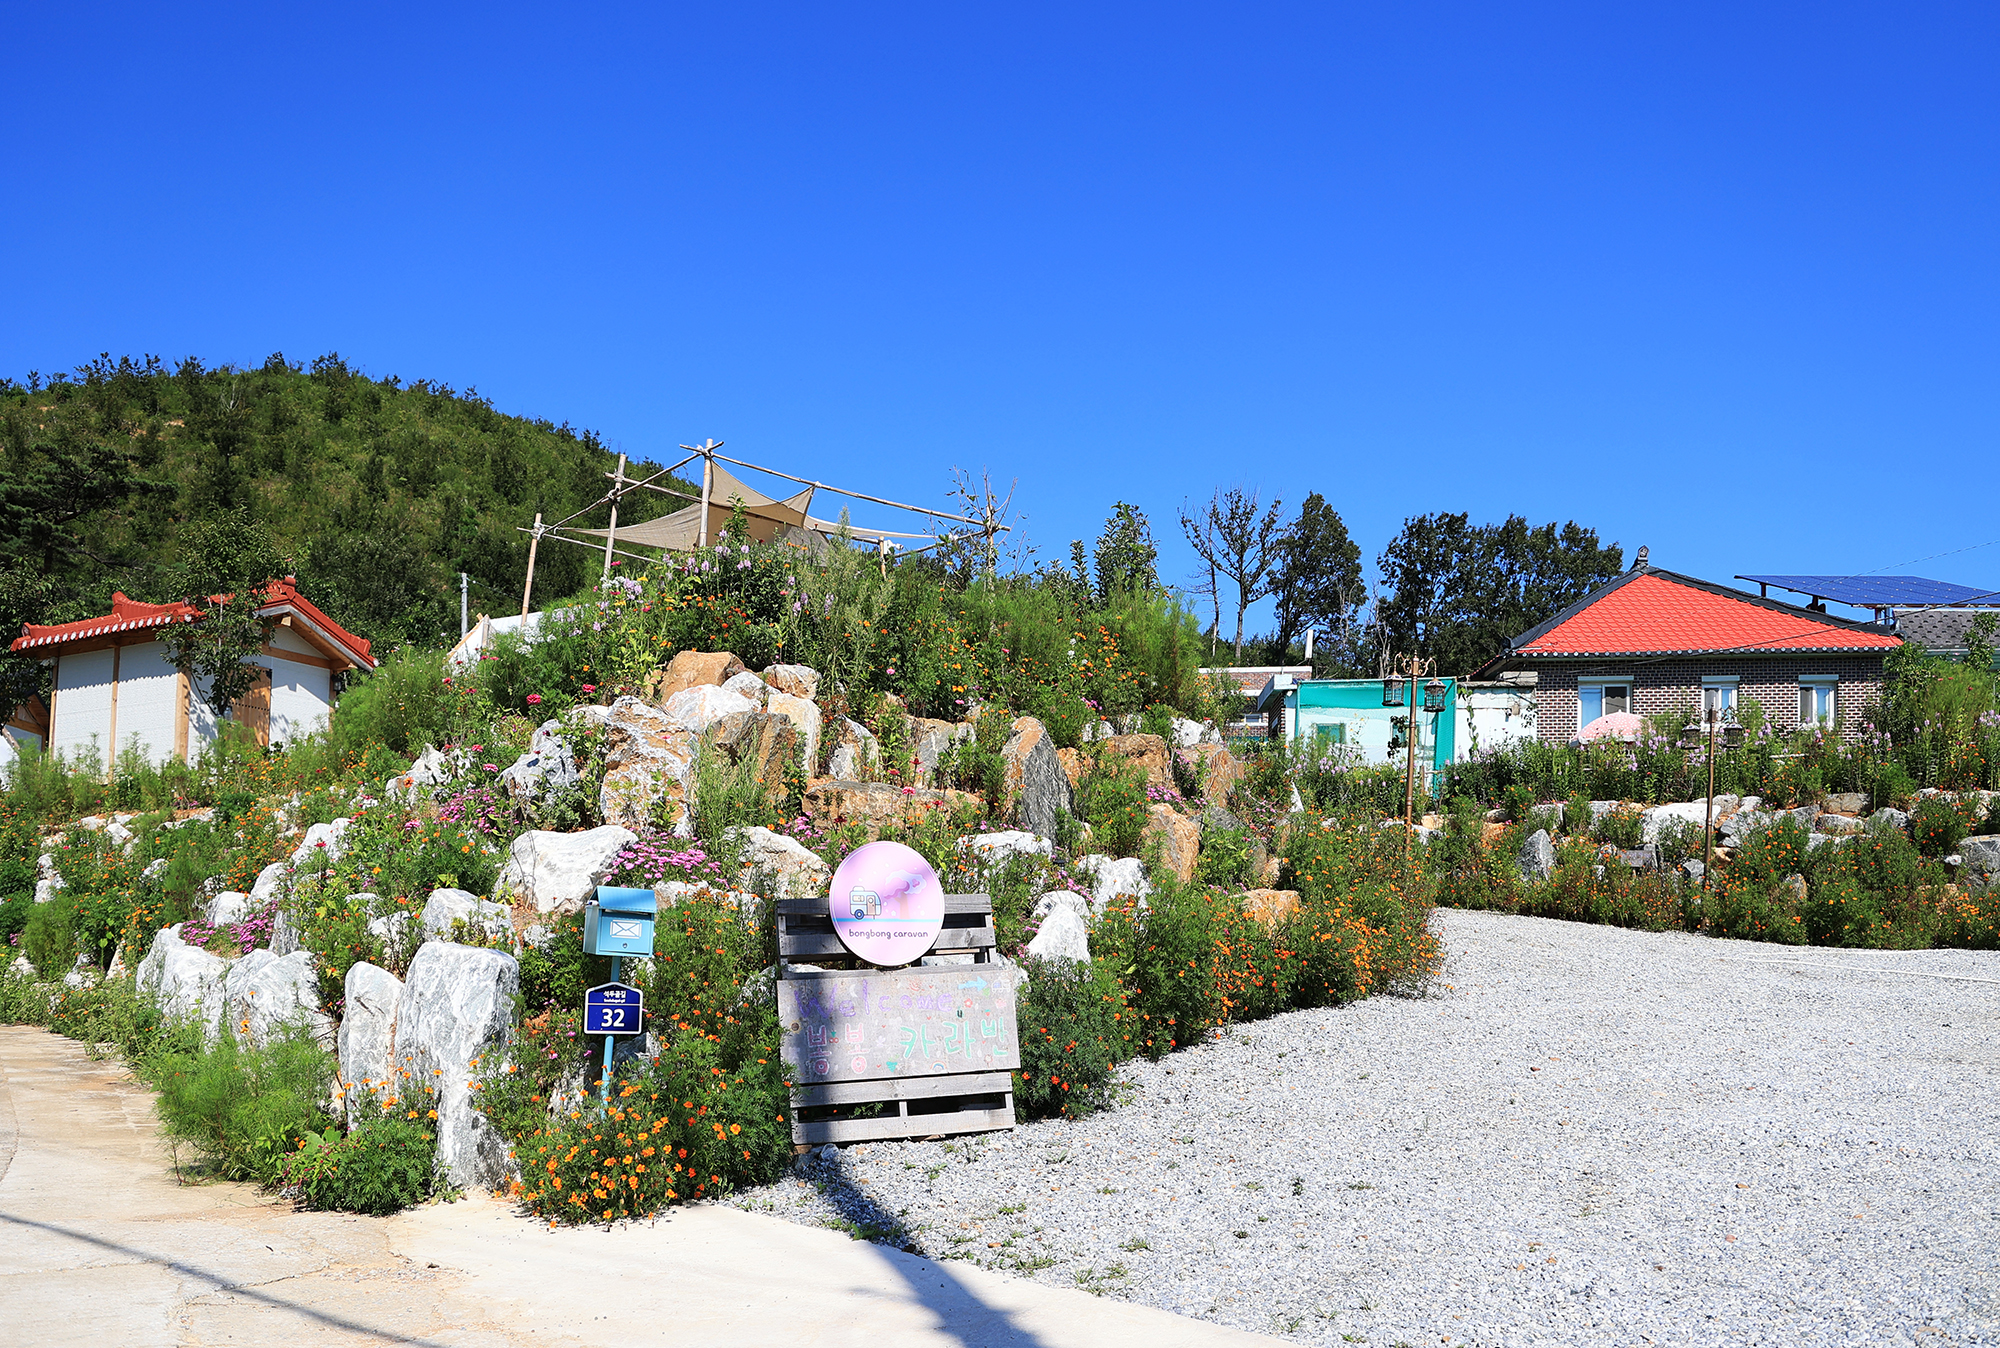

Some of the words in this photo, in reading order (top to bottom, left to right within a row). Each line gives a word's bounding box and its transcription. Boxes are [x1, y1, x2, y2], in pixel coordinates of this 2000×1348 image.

[848, 928, 892, 940] bongbong
[893, 930, 929, 938] caravan
[793, 979, 952, 1018] Welcome
[601, 1008, 625, 1028] 32
[807, 1022, 871, 1075] 봉봉
[900, 1016, 1008, 1059] 카라반
